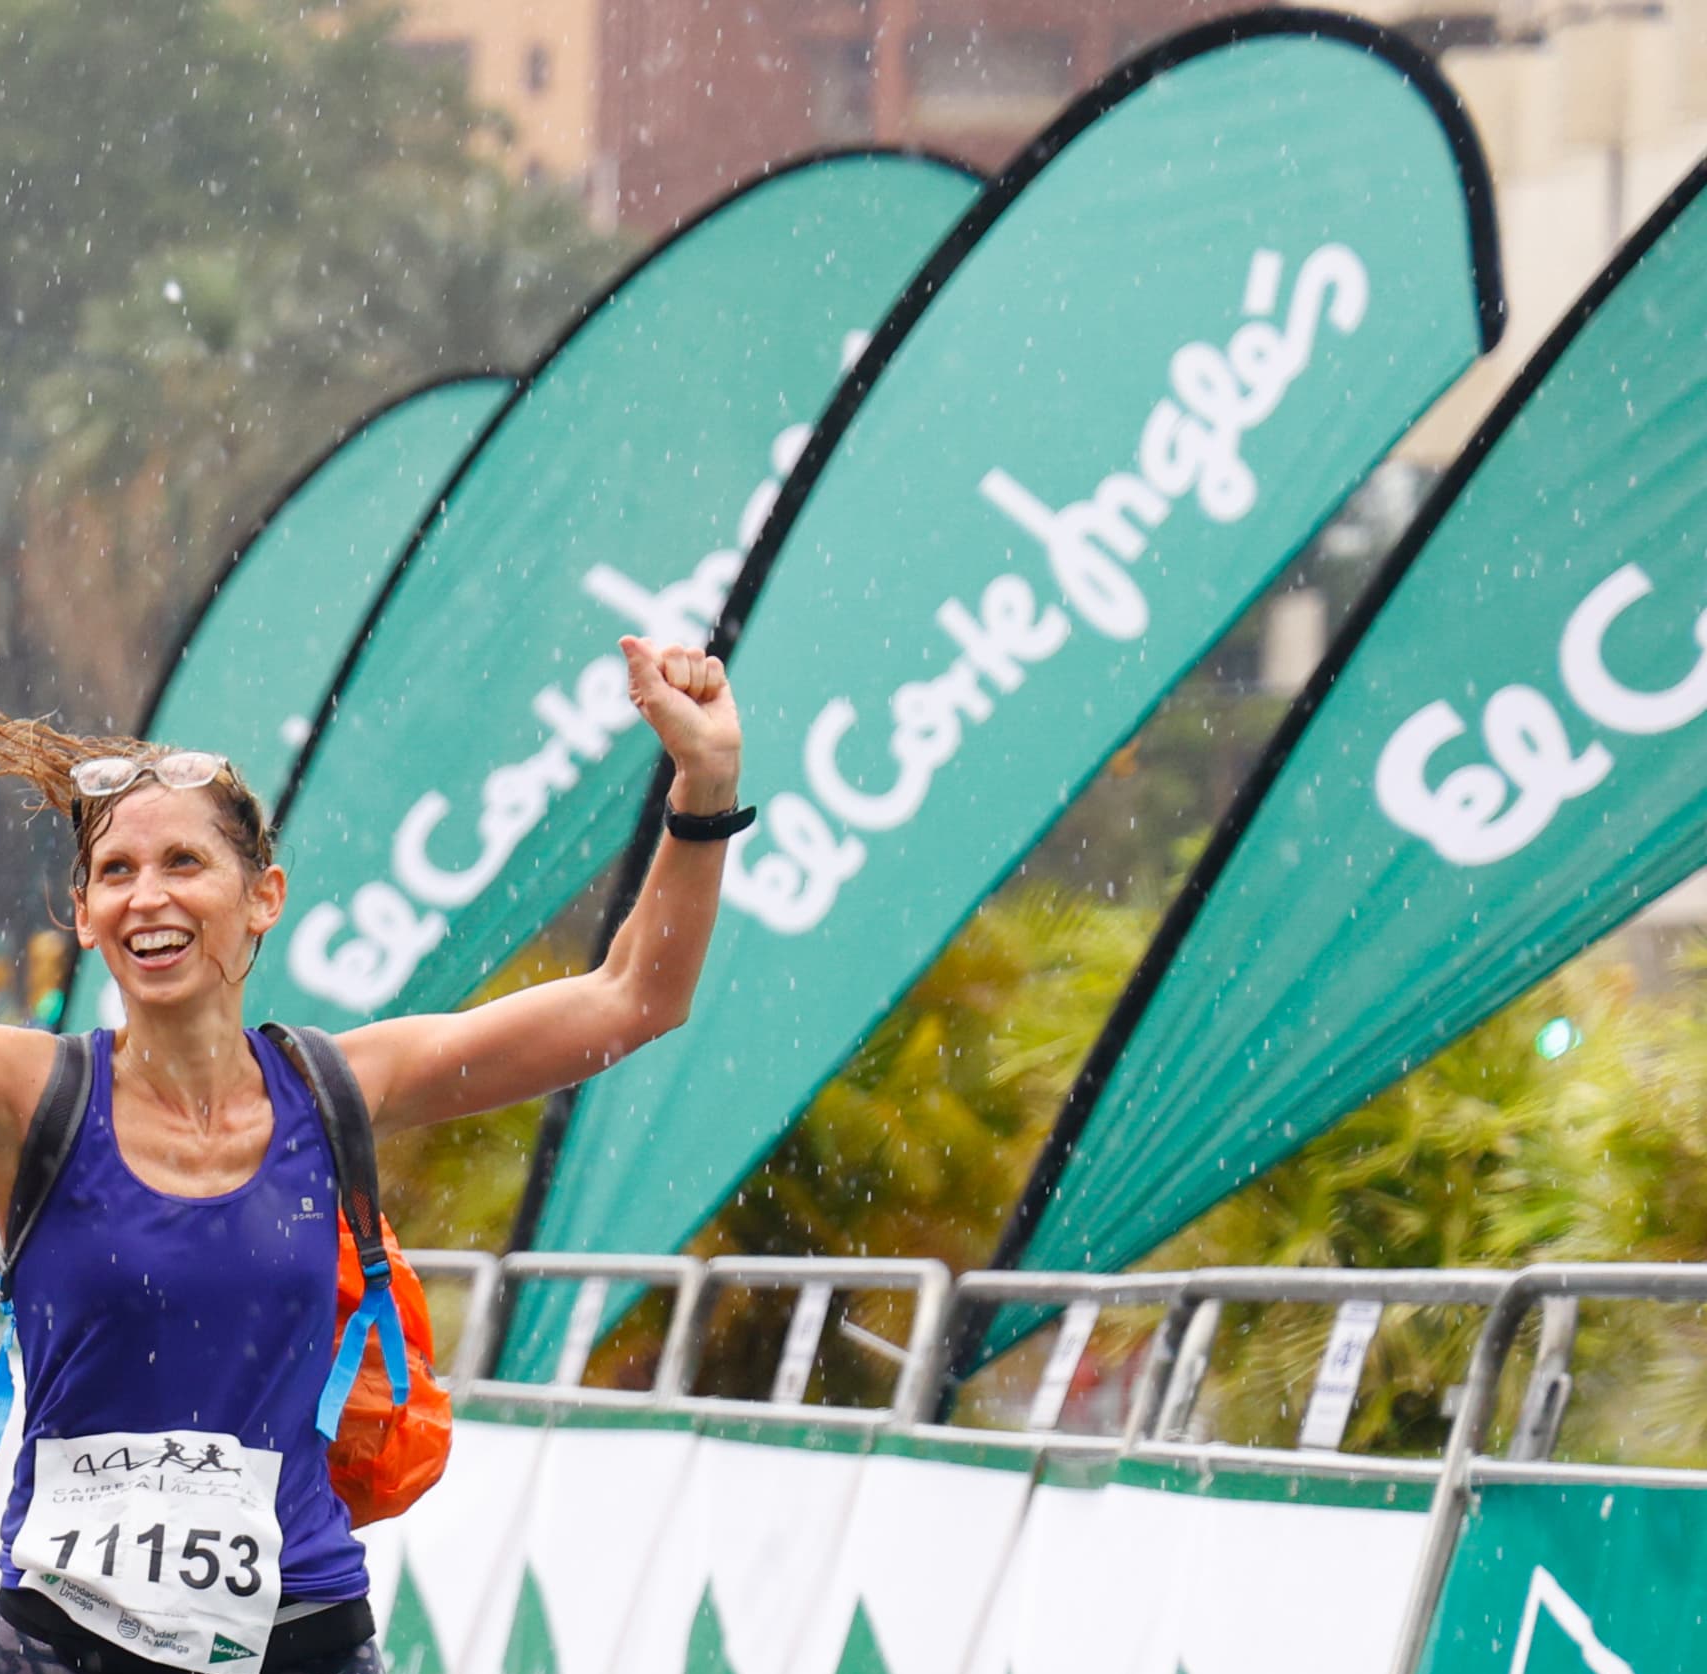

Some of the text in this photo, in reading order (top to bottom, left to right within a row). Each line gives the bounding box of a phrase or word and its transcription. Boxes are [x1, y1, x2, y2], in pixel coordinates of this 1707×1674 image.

[804, 574, 1070, 831] Corte
[978, 243, 1369, 640] Inglés
[289, 655, 643, 1013] El Corte
[1375, 683, 1615, 866] El
[49, 1523, 262, 1597] 11153
